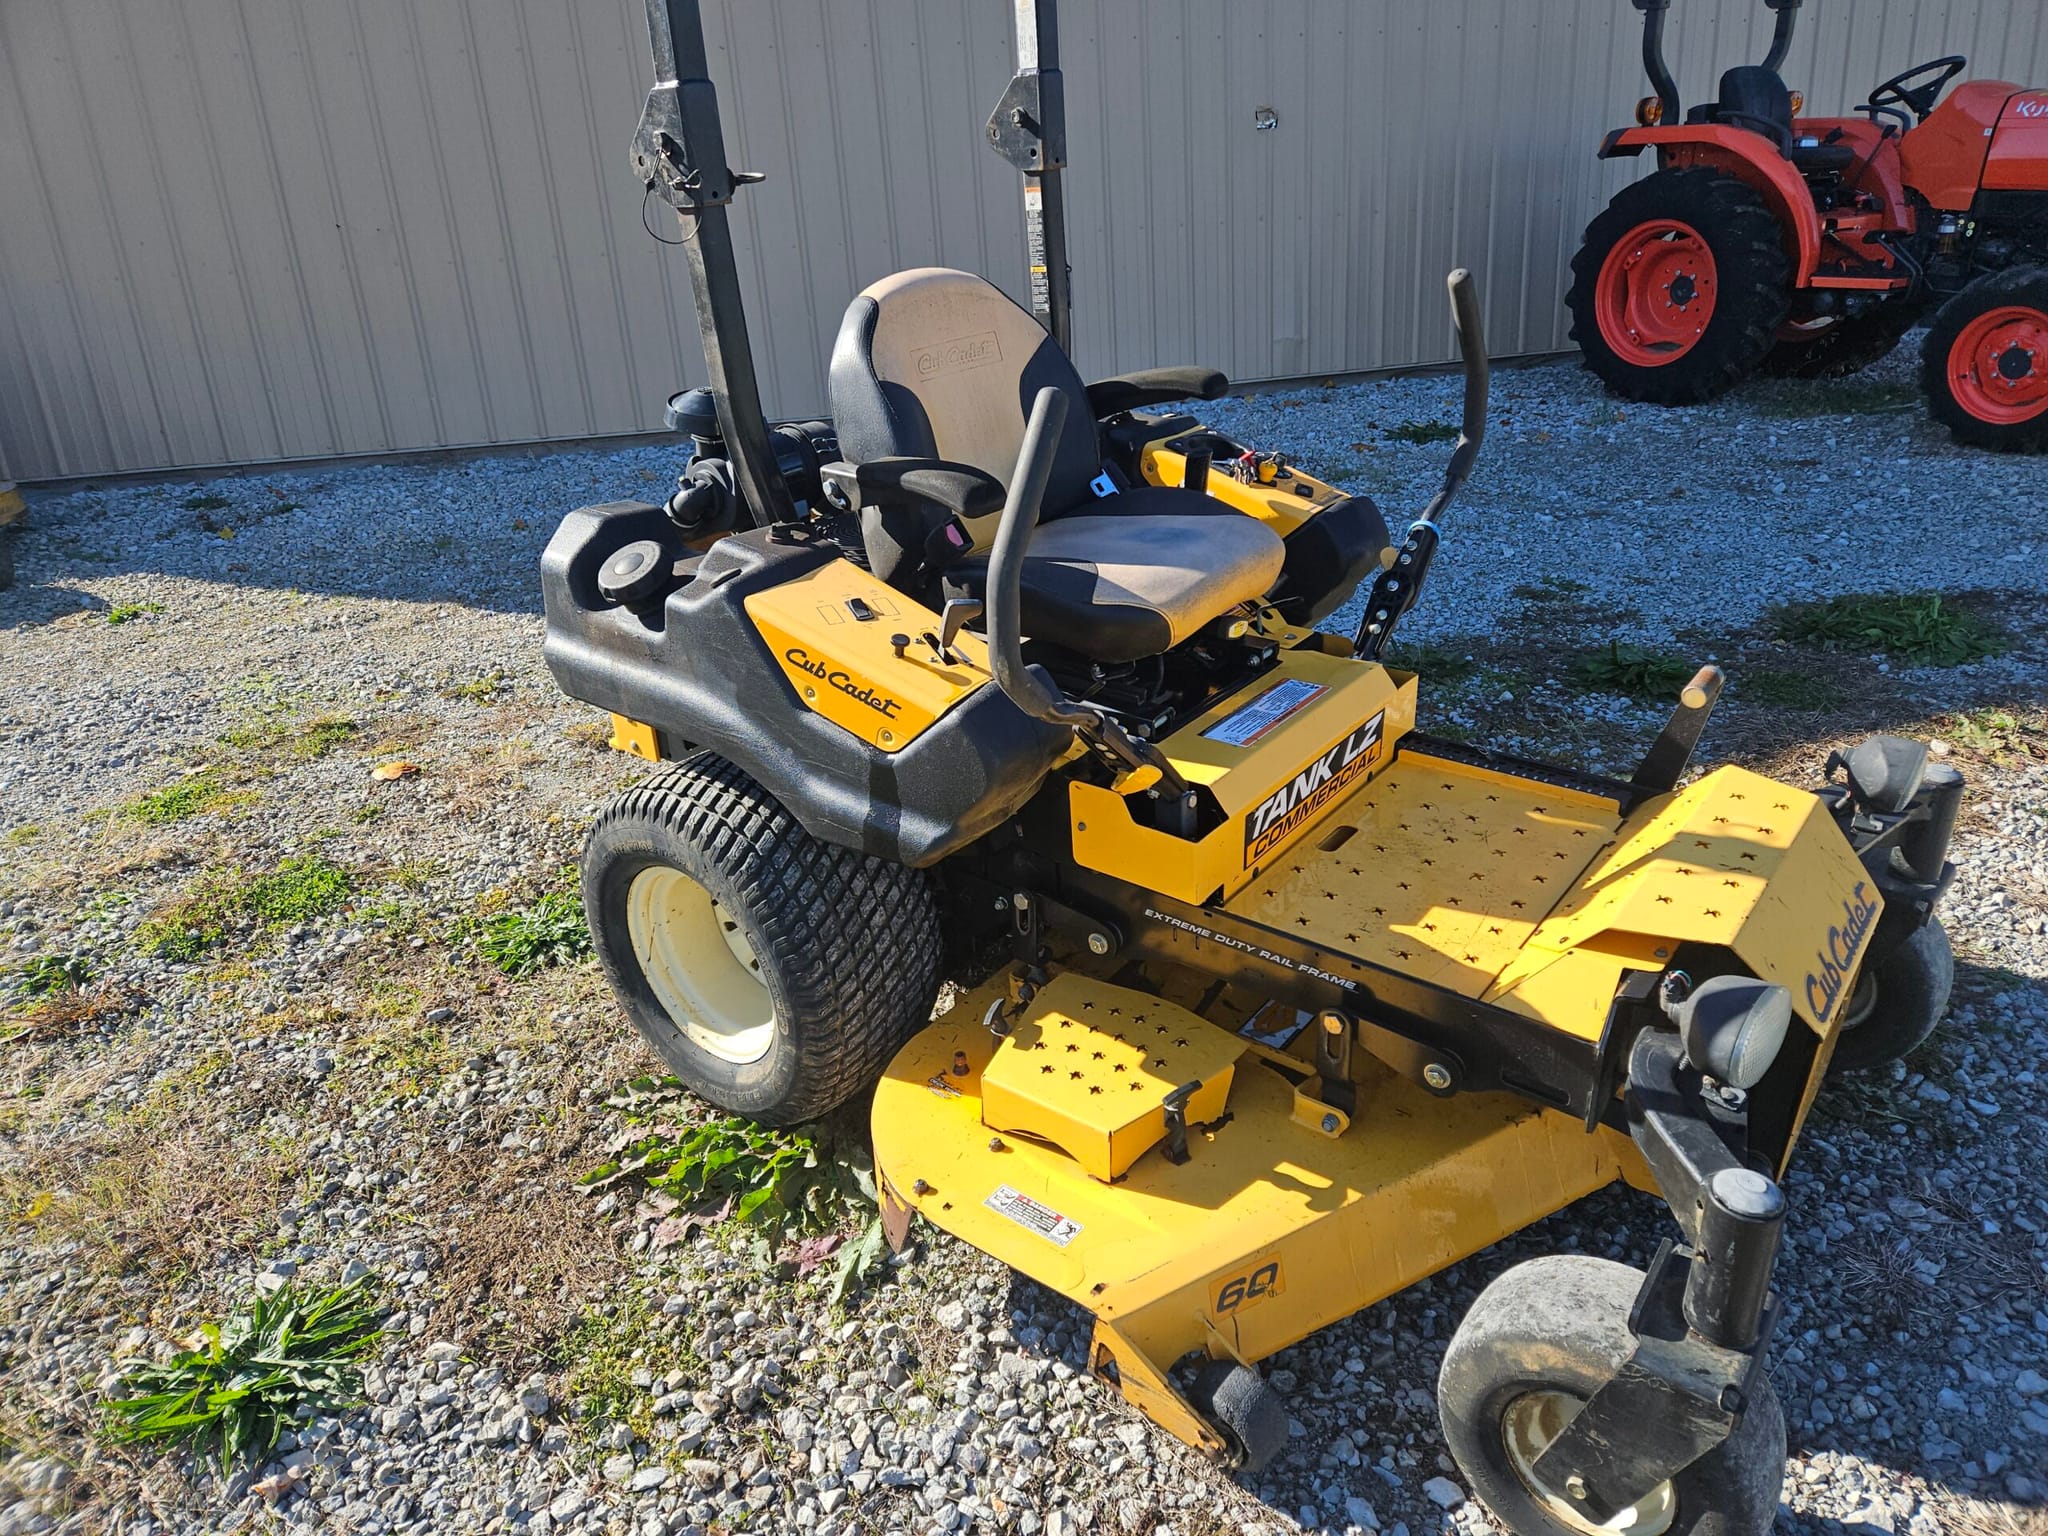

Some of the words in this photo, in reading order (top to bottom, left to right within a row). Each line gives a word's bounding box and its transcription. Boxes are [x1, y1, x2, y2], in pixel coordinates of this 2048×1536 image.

[2016, 101, 2048, 117] Ku
[785, 648, 826, 679] Cub
[828, 671, 902, 720] Cadet
[1252, 744, 1341, 840] TANK
[1342, 711, 1384, 768] LZ
[1253, 747, 1376, 859] COMMERCIAL
[1144, 908, 1212, 937] EXTREME
[1214, 934, 1257, 953] DUTY
[1259, 950, 1294, 968] RAIL
[1297, 964, 1357, 990] FRAME
[1806, 950, 1842, 1023] Cub
[1828, 881, 1877, 972] Cadet
[1216, 1262, 1278, 1313] 60
